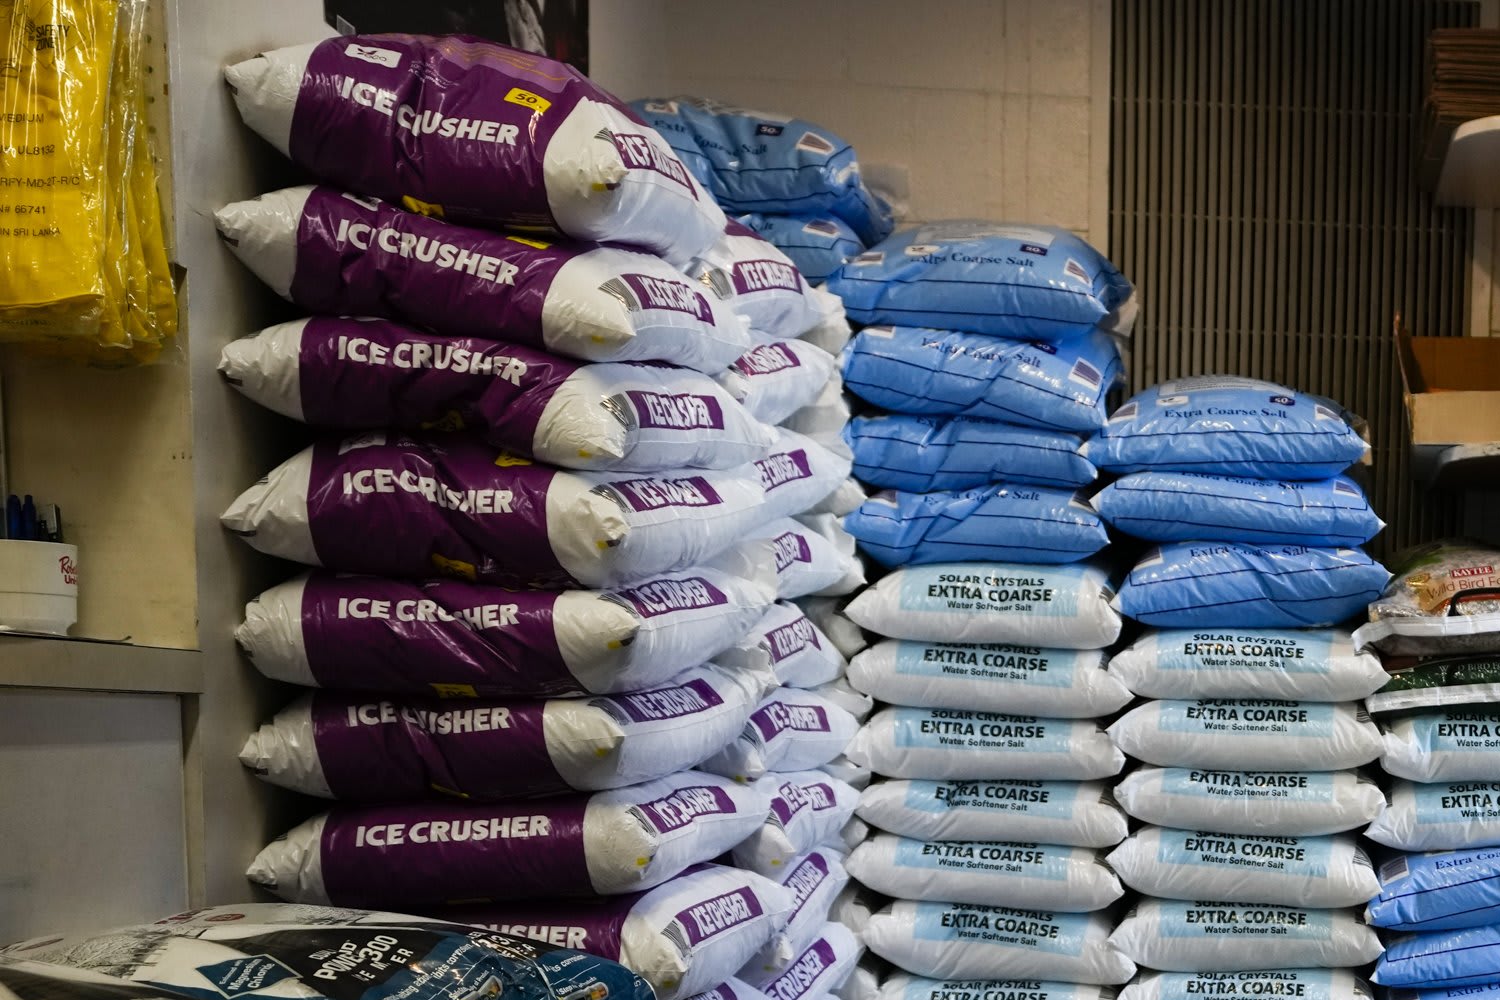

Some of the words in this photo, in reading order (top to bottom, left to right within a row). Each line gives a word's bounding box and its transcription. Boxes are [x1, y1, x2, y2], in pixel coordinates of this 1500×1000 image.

[341, 76, 397, 117] ICE
[514, 93, 537, 104] 50
[15, 204, 46, 214] 66741
[14, 228, 29, 236] SRI
[378, 228, 520, 287] CRUSHER
[338, 336, 390, 366] ICE
[1164, 409, 1203, 419] Extra
[1207, 406, 1258, 417] Coarse
[343, 469, 396, 495] ICE
[1452, 567, 1494, 578] KAYTEE
[928, 585, 983, 600] EXTRA
[988, 589, 1053, 602] COARSE
[1427, 580, 1455, 599] Wild
[1459, 577, 1485, 589] Bird
[338, 598, 391, 620] ICE
[1194, 633, 1233, 642] SOLAR
[1184, 643, 1236, 656] EXTRA
[1241, 645, 1304, 659] COARSE
[924, 649, 978, 667] EXTRA
[983, 654, 1048, 672] COARSE
[1202, 658, 1227, 667] Water
[970, 668, 1008, 679] Softener
[348, 700, 398, 728] ICE
[1187, 707, 1238, 721] EXTRA
[1243, 709, 1307, 723] COARSE
[920, 720, 975, 736] EXTRA
[980, 724, 1045, 739] COARSE
[1438, 724, 1491, 737] EXTRA
[1456, 739, 1482, 747] Water
[1190, 772, 1241, 788] EXTRA
[985, 786, 1050, 803] COARSE
[1207, 787, 1232, 796] Water
[1449, 783, 1488, 793] SOLAR
[971, 800, 1009, 811] Softener
[1010, 802, 1028, 812] Salt
[1442, 794, 1493, 808] EXTRA
[356, 823, 406, 848] ICE
[408, 815, 549, 844] CRUSHER
[922, 844, 974, 859] EXTRA
[979, 848, 1044, 865] COARSE
[1185, 839, 1236, 855] EXTRA
[1241, 843, 1304, 861] COARSE
[938, 858, 965, 868] Water
[966, 861, 1004, 872] Softener
[1006, 864, 1022, 873] Salt
[1202, 855, 1227, 864] Water
[1229, 857, 1265, 868] Softener
[1268, 861, 1284, 869] Salt
[1435, 857, 1473, 870] Extra
[1186, 910, 1238, 924] EXTRA
[1243, 911, 1307, 925] COARSE
[941, 912, 989, 930] EXTRA
[994, 918, 1060, 939] COARSE
[1205, 926, 1230, 935] Water
[1232, 926, 1269, 935] Softener
[1270, 927, 1287, 935] Salt
[981, 932, 1019, 945] Softener
[1020, 936, 1037, 946] Salt
[1238, 973, 1297, 981] CRYSTALS
[1187, 981, 1237, 994] EXTRA
[1242, 982, 1305, 997] COARSE
